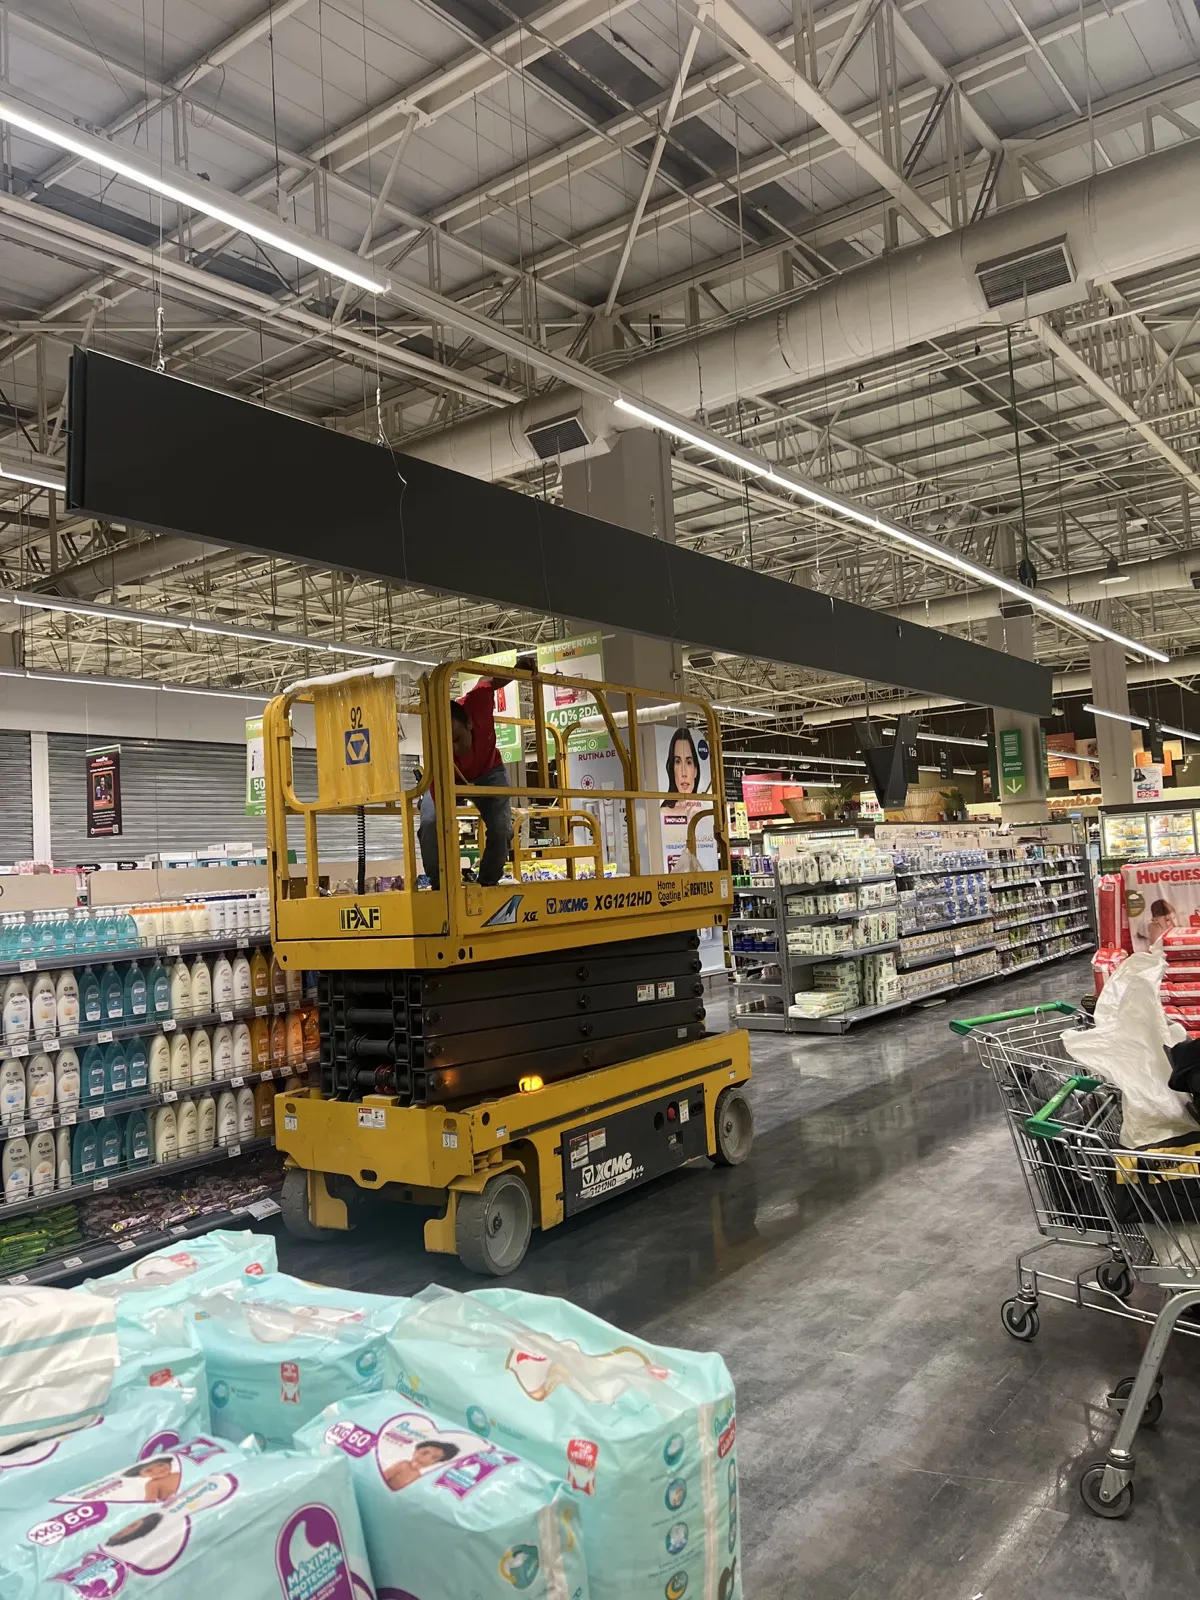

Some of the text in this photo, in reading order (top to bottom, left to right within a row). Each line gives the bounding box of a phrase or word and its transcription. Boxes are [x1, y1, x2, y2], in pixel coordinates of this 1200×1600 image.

[562, 650, 576, 658] abril
[350, 706, 363, 729] 92
[550, 705, 599, 727] 40% 2DA
[578, 751, 605, 762] RUTINA
[605, 749, 616, 759] DE
[1136, 868, 1200, 885] HUGGIES
[657, 880, 676, 891] Home
[690, 881, 714, 897] RENTALS
[556, 890, 653, 915] XCMG XG1212HD
[657, 890, 682, 902] Coating
[341, 902, 380, 929] IPAF
[522, 911, 538, 923] XG
[594, 1152, 633, 1183] XCMG
[349, 1430, 372, 1448] 60
[64, 1505, 94, 1525] 60
[31, 1524, 64, 1541] XXG
[286, 1541, 340, 1589] MÁXIMA
